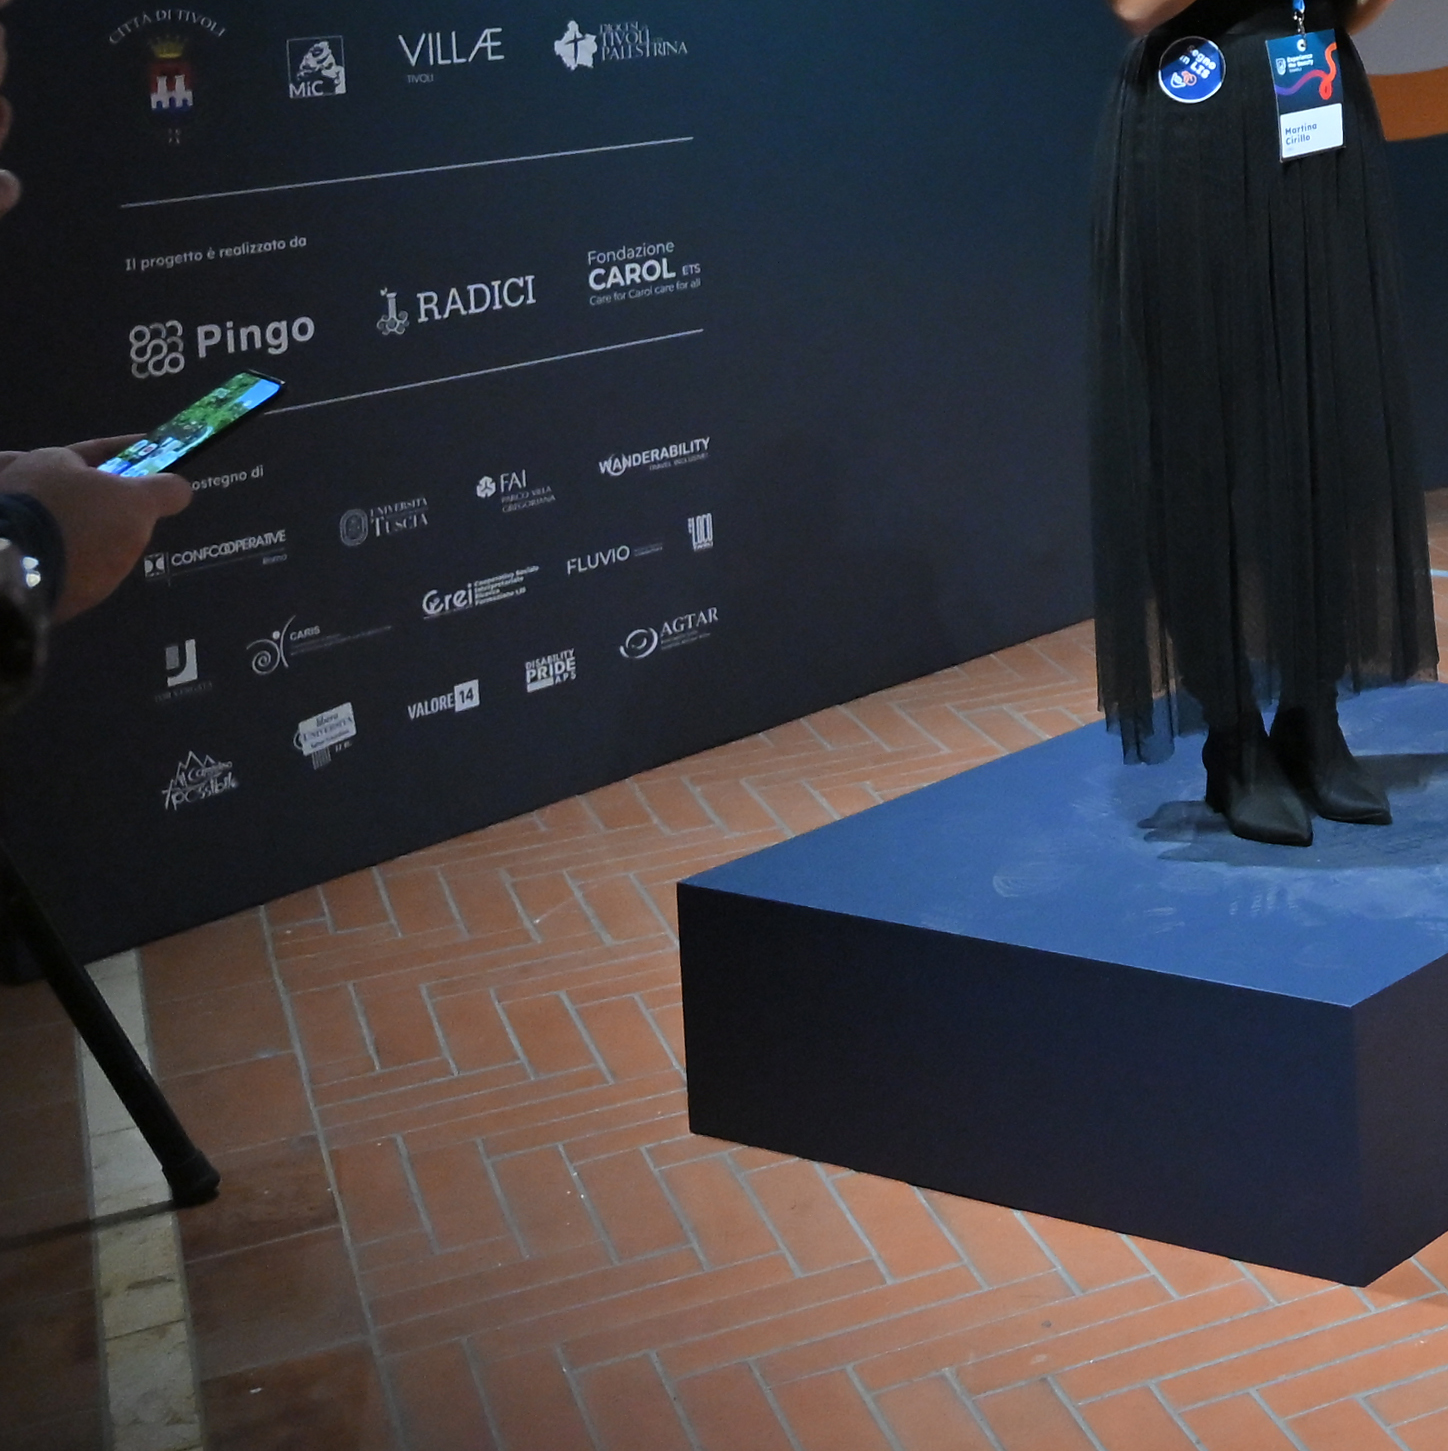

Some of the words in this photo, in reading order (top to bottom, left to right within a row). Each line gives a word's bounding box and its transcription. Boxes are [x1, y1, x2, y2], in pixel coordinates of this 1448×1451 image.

[155, 9, 171, 21] DI
[177, 9, 226, 37] TIVOLI
[289, 81, 324, 98] MiC
[1285, 122, 1318, 136] Martina
[126, 258, 137, 271] Il
[141, 251, 203, 271] progetto
[207, 246, 215, 260] è
[219, 240, 286, 258] realizzato
[289, 236, 307, 248] da
[588, 241, 675, 265] Fondazione
[588, 257, 676, 290] CAROL
[416, 274, 537, 323] RADICI
[197, 316, 315, 358] Pingo
[599, 436, 711, 475] WANDERABILITY
[191, 470, 247, 491] ostegno
[251, 464, 264, 479] di
[500, 469, 526, 493] FAI
[566, 545, 631, 575] FLUVIO
[290, 625, 321, 642] CARIS
[660, 606, 719, 637] AGTAR
[525, 648, 574, 670] DISABILITY
[526, 656, 576, 683] PRIDE
[407, 692, 456, 721] VALORE
[459, 687, 474, 704] 14
